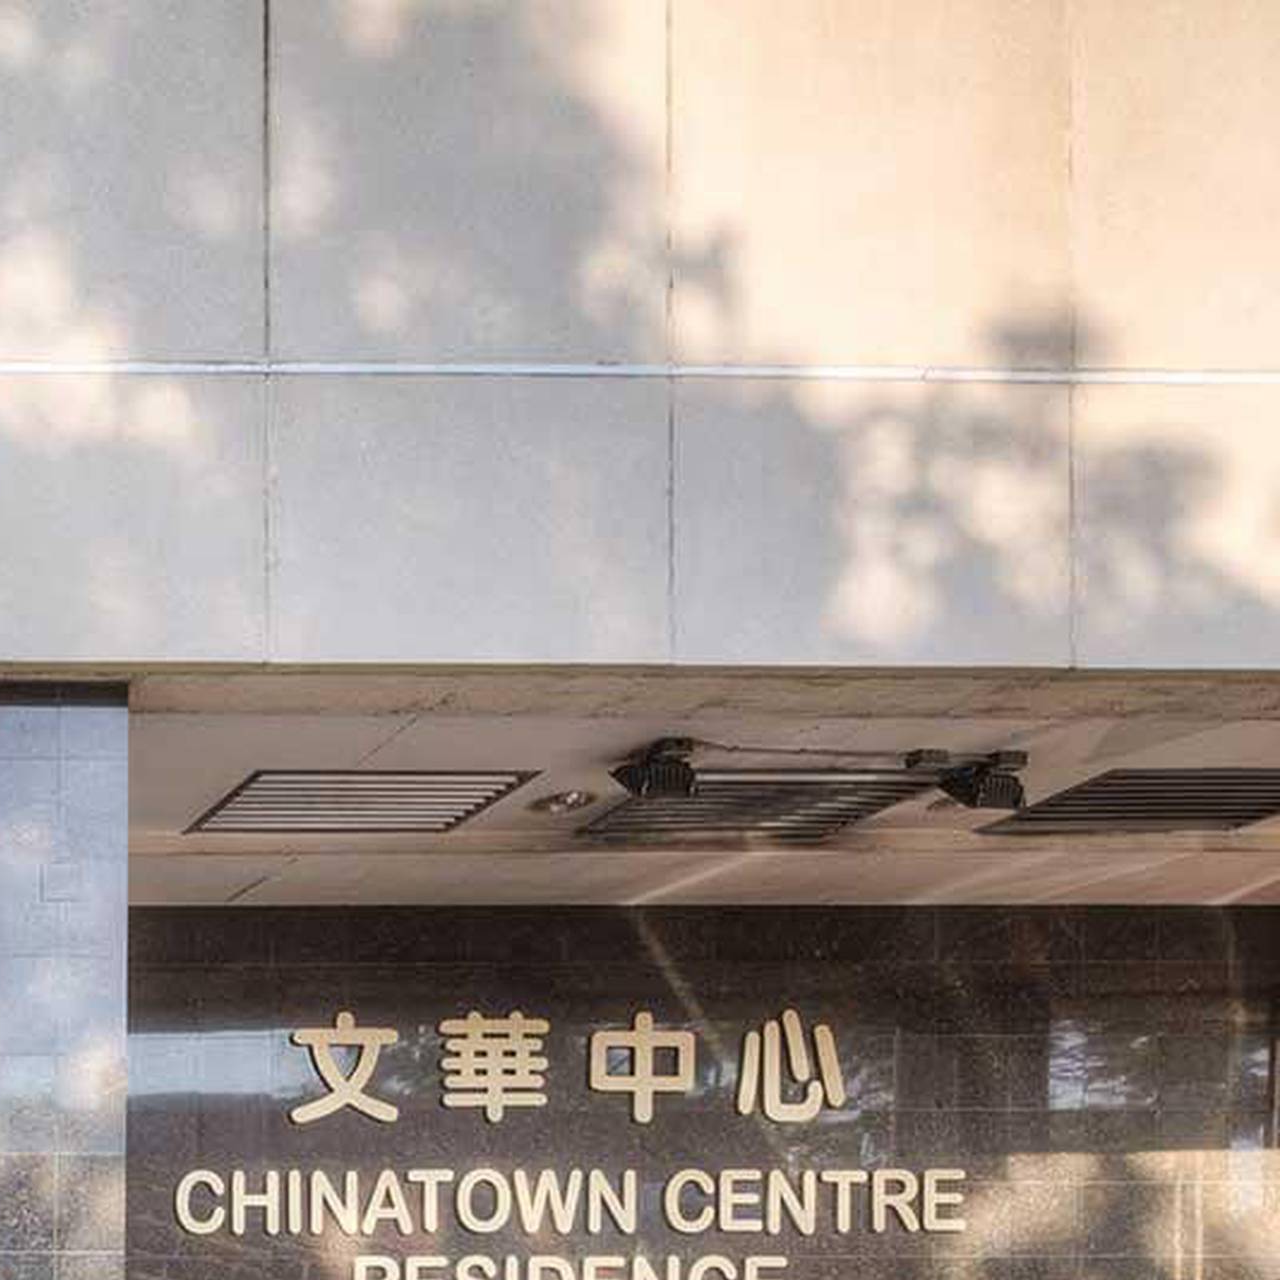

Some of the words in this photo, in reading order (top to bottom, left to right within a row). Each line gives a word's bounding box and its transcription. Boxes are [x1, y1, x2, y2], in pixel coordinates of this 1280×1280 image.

[288, 1009, 846, 1125] 文華中心
[174, 1168, 638, 1237] CHINATOWN
[663, 1168, 968, 1236] CENTRE
